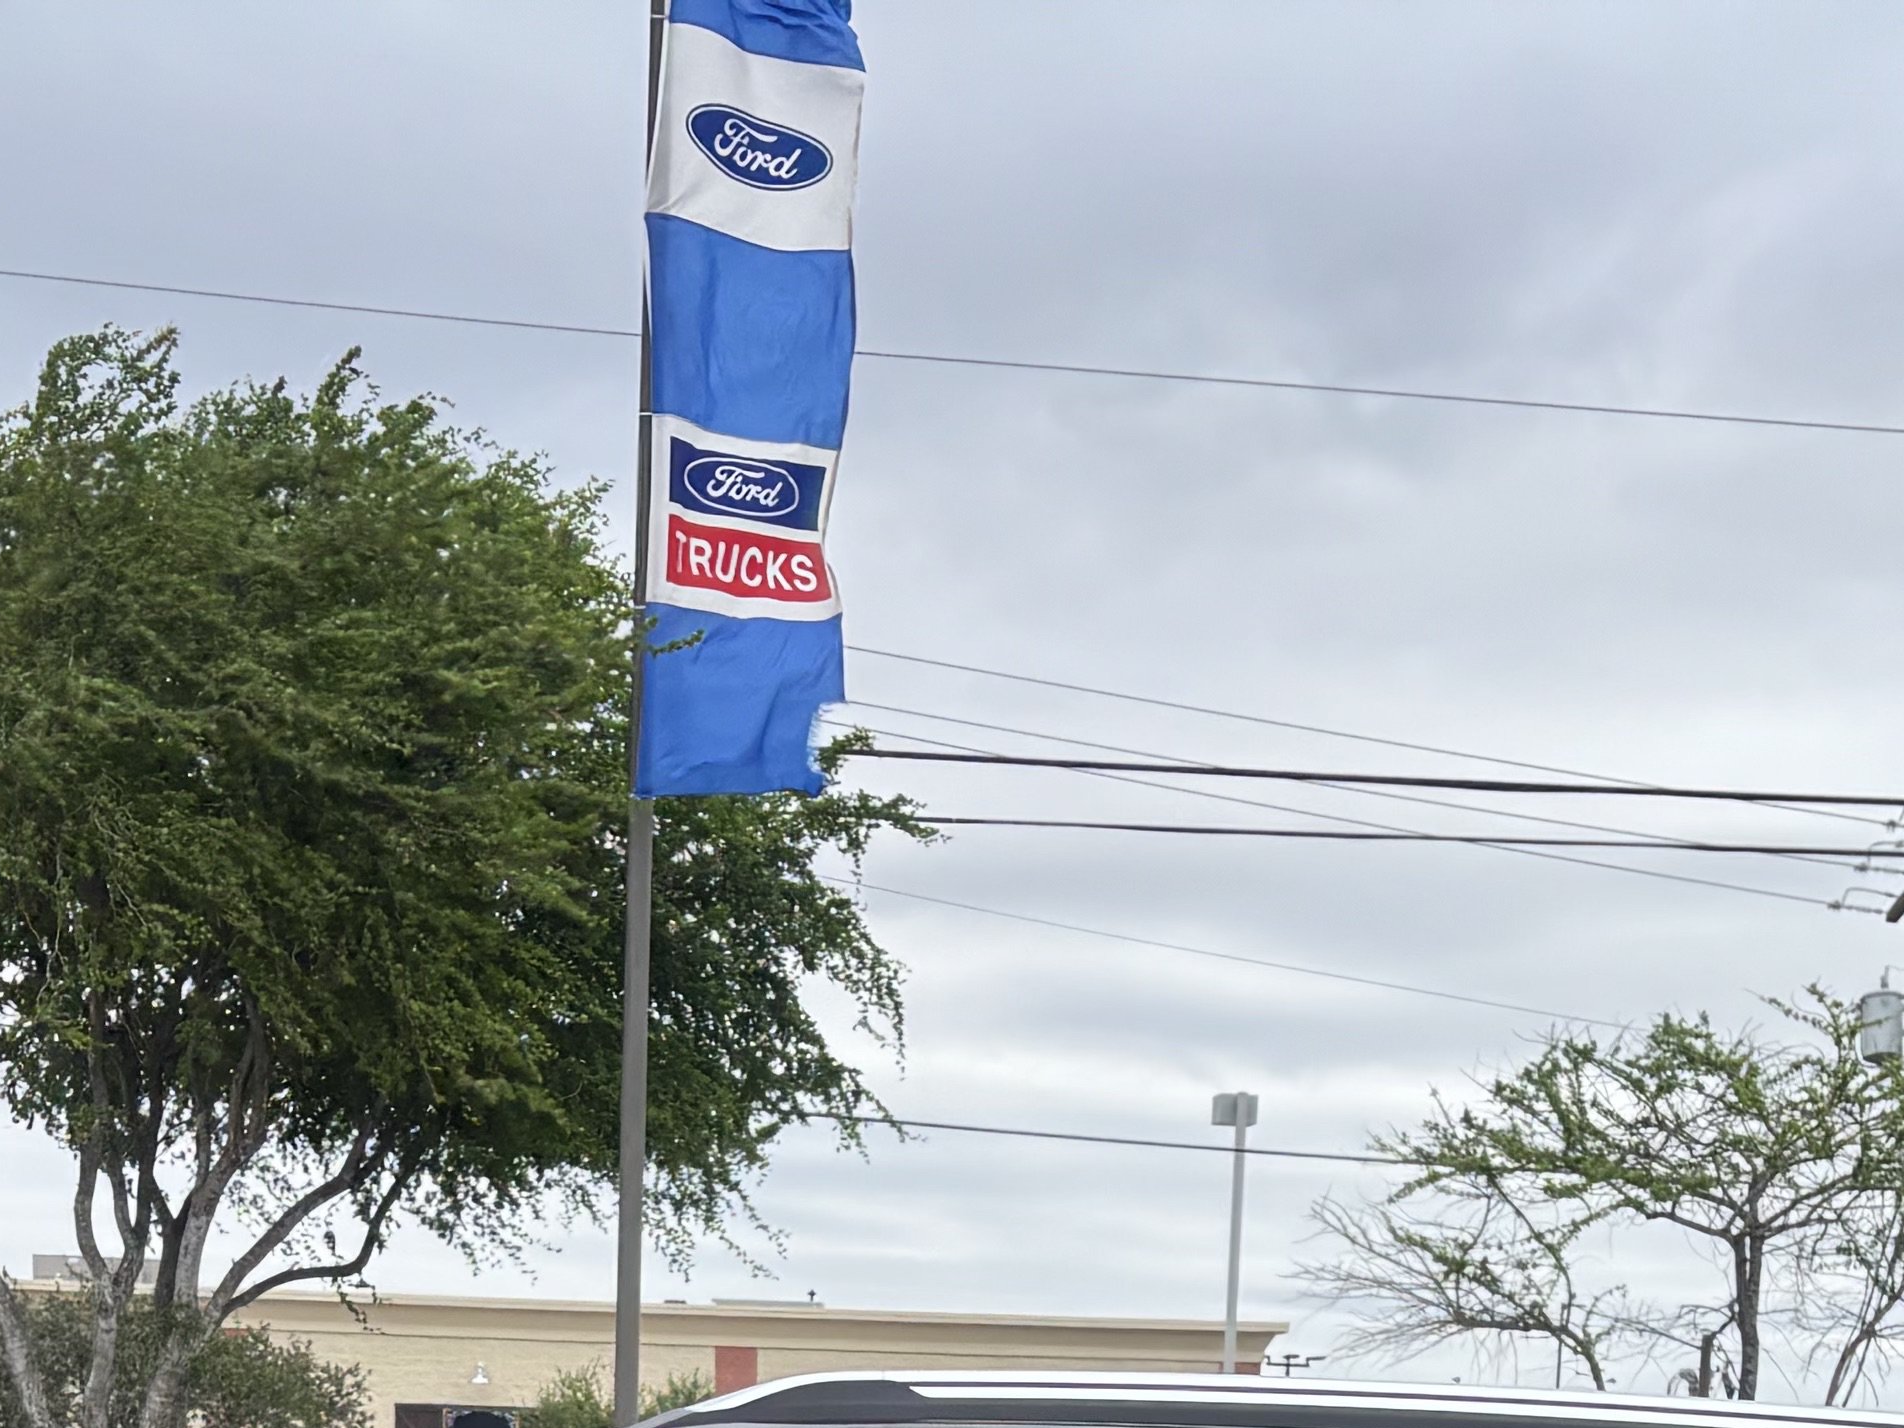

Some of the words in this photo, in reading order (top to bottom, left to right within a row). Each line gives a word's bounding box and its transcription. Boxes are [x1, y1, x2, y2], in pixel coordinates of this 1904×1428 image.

[713, 116, 798, 180] Ford
[705, 464, 783, 508] Ford
[675, 530, 818, 593] TRUCKS
